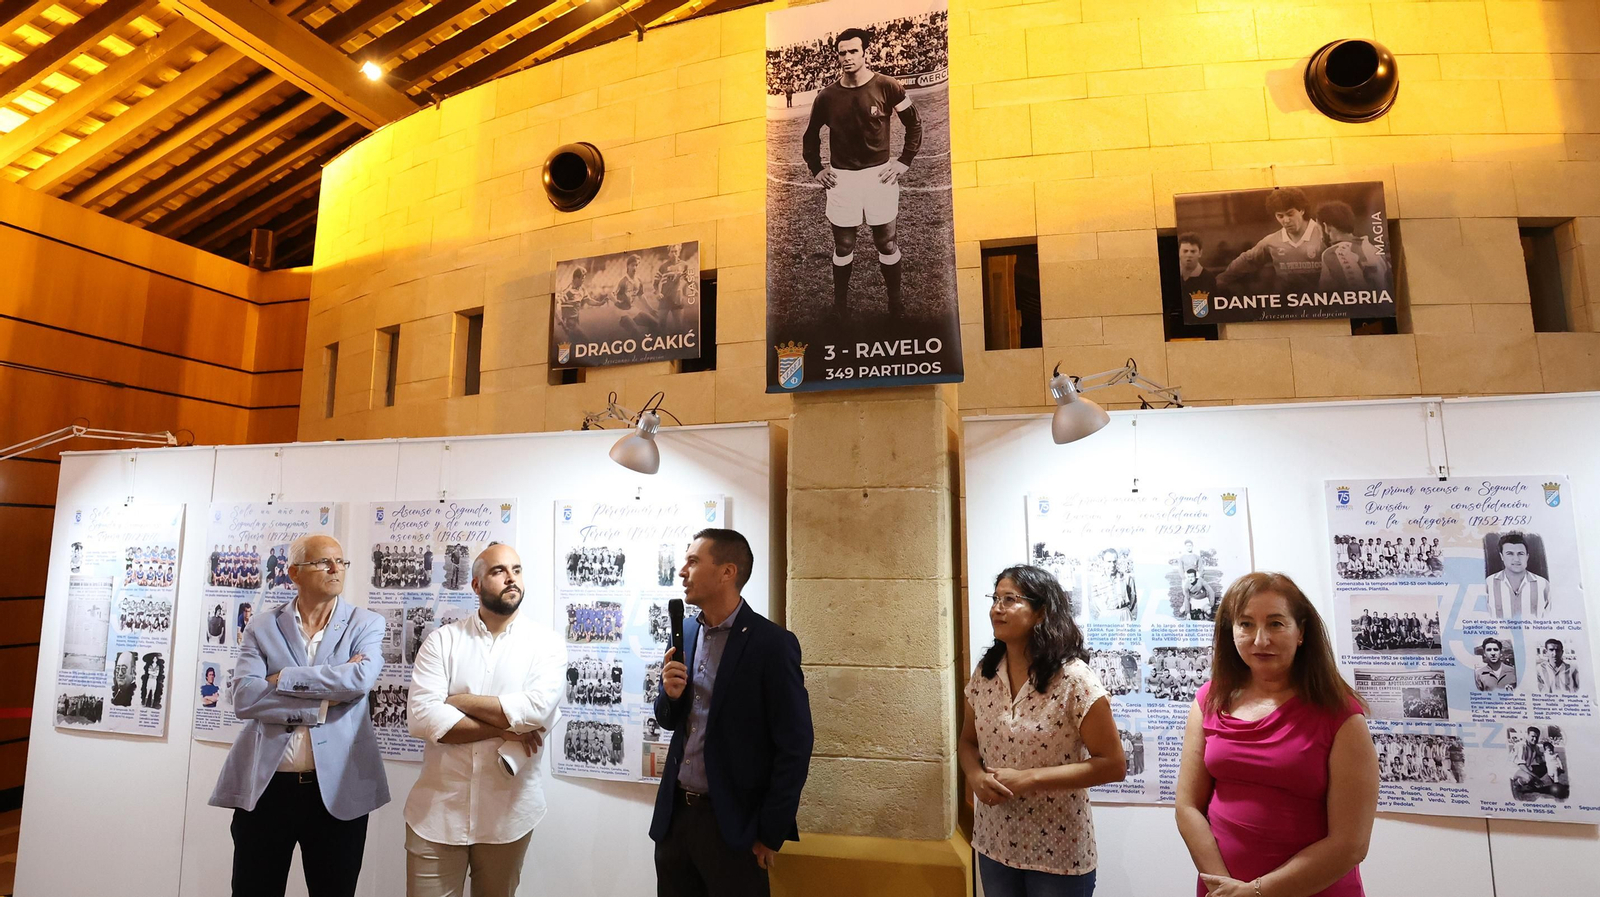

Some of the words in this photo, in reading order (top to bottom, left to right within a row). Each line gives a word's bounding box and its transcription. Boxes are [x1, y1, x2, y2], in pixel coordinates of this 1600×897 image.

[1372, 211, 1385, 256] MAGIA
[687, 268, 695, 305] CLASE
[1214, 294, 1281, 310] DANTE
[1287, 290, 1393, 307] SANABRIA
[575, 339, 637, 358] DRAGO
[641, 329, 696, 352] ČAKIĆ
[824, 345, 836, 360] 3
[856, 337, 942, 358] RAVELO
[825, 367, 854, 380] 349
[859, 362, 942, 378] PARTIDOS
[1364, 482, 1382, 497] El
[1381, 485, 1416, 498] primer
[1420, 485, 1458, 494] ascenso
[1478, 480, 1528, 496] Segunda
[1164, 492, 1208, 506] Segunda
[1365, 501, 1410, 514] División
[1423, 504, 1433, 514] y
[1450, 496, 1531, 512] consolidación
[230, 504, 253, 518] Solo
[392, 505, 432, 517] Ascenso
[445, 503, 492, 519] Segunda,
[1139, 506, 1209, 522] consolidación
[390, 518, 430, 531] descenso
[433, 522, 440, 532] y
[446, 517, 458, 530] de
[1385, 513, 1399, 528] la
[1408, 515, 1459, 528] categoría
[1468, 515, 1532, 526] (1952-1958)
[239, 531, 264, 542] Tercera
[390, 532, 431, 542] ascenso
[437, 530, 491, 542] (1966-1971)
[580, 525, 620, 543] Tercera
[1100, 524, 1146, 537] categoría
[1155, 524, 1210, 535] (1952-1958)
